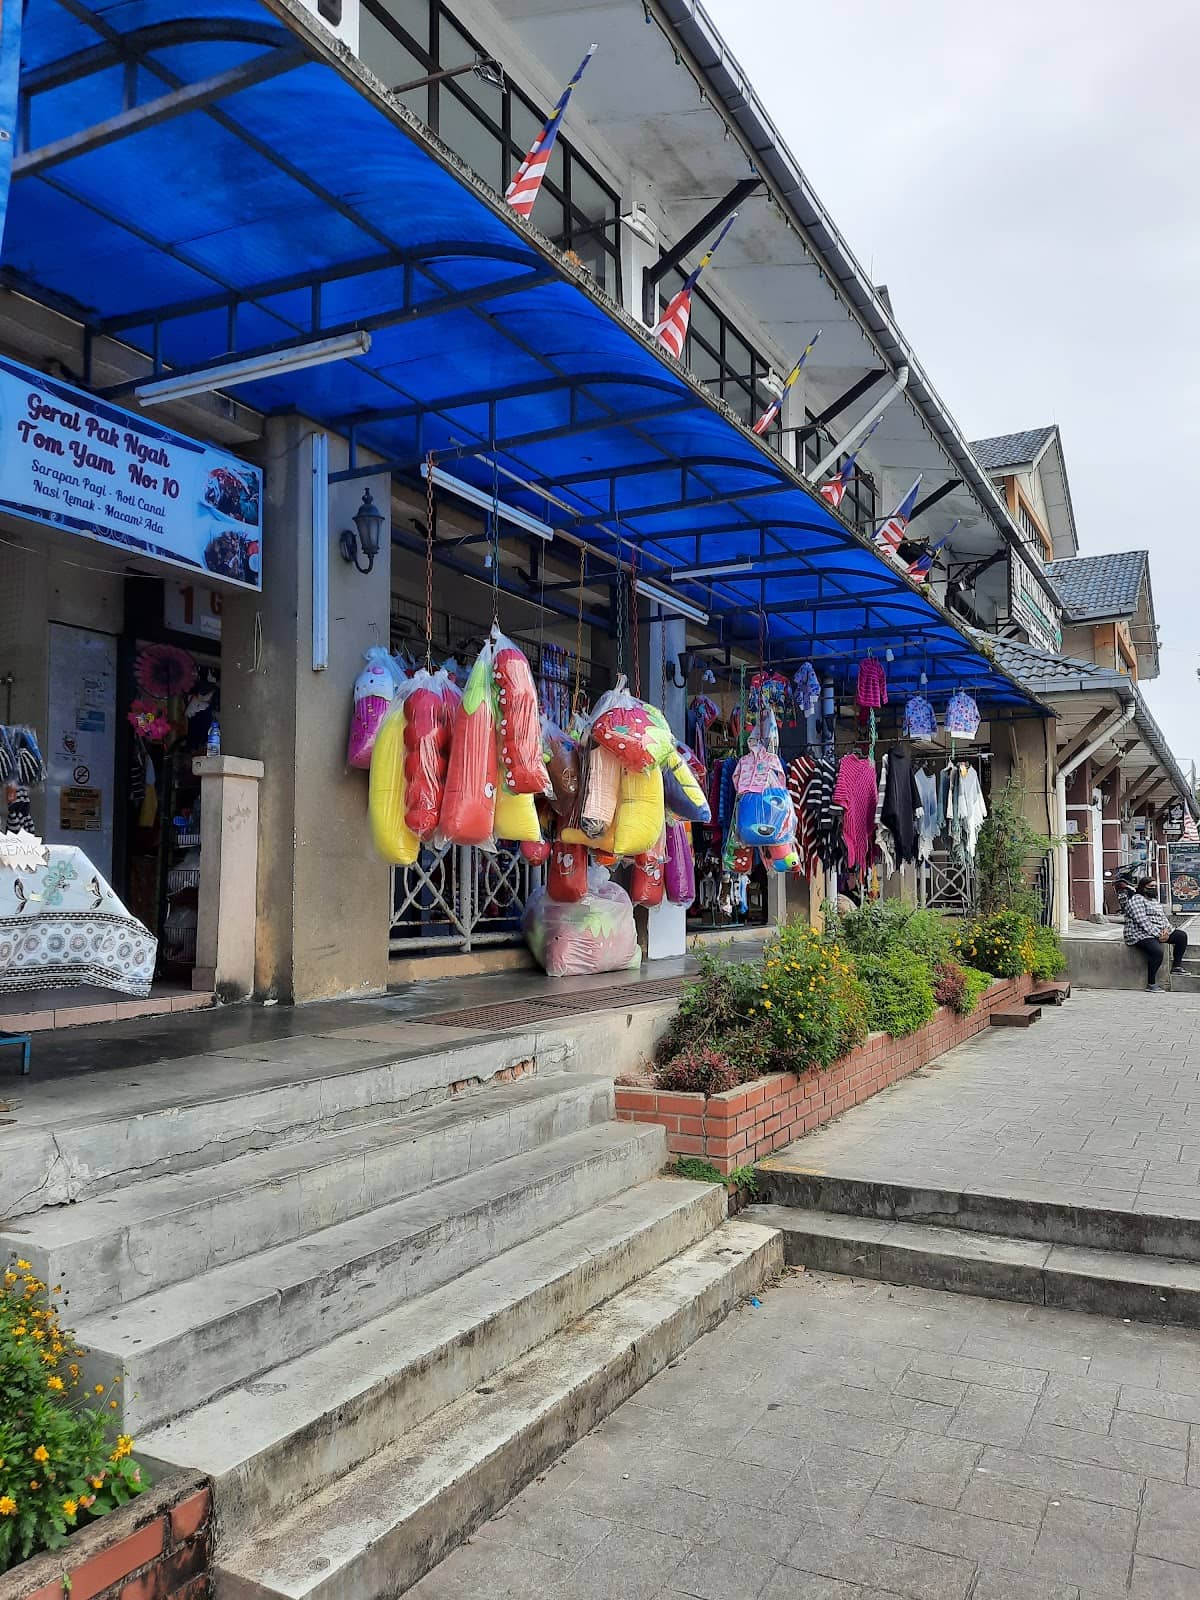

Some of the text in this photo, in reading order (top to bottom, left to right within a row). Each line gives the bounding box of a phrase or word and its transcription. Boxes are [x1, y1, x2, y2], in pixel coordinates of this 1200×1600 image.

[17, 420, 65, 456] Tom
[69, 440, 116, 475] Yam
[162, 477, 180, 499] 10
[27, 393, 171, 468] Gerai Pak Ngah
[31, 459, 80, 487] Sarapan
[82, 478, 107, 498] Pagi
[115, 489, 136, 506] Roti
[137, 498, 166, 517] Canai
[33, 479, 60, 499] Nasi
[62, 489, 96, 511] Lemak
[144, 518, 165, 534] Ada
